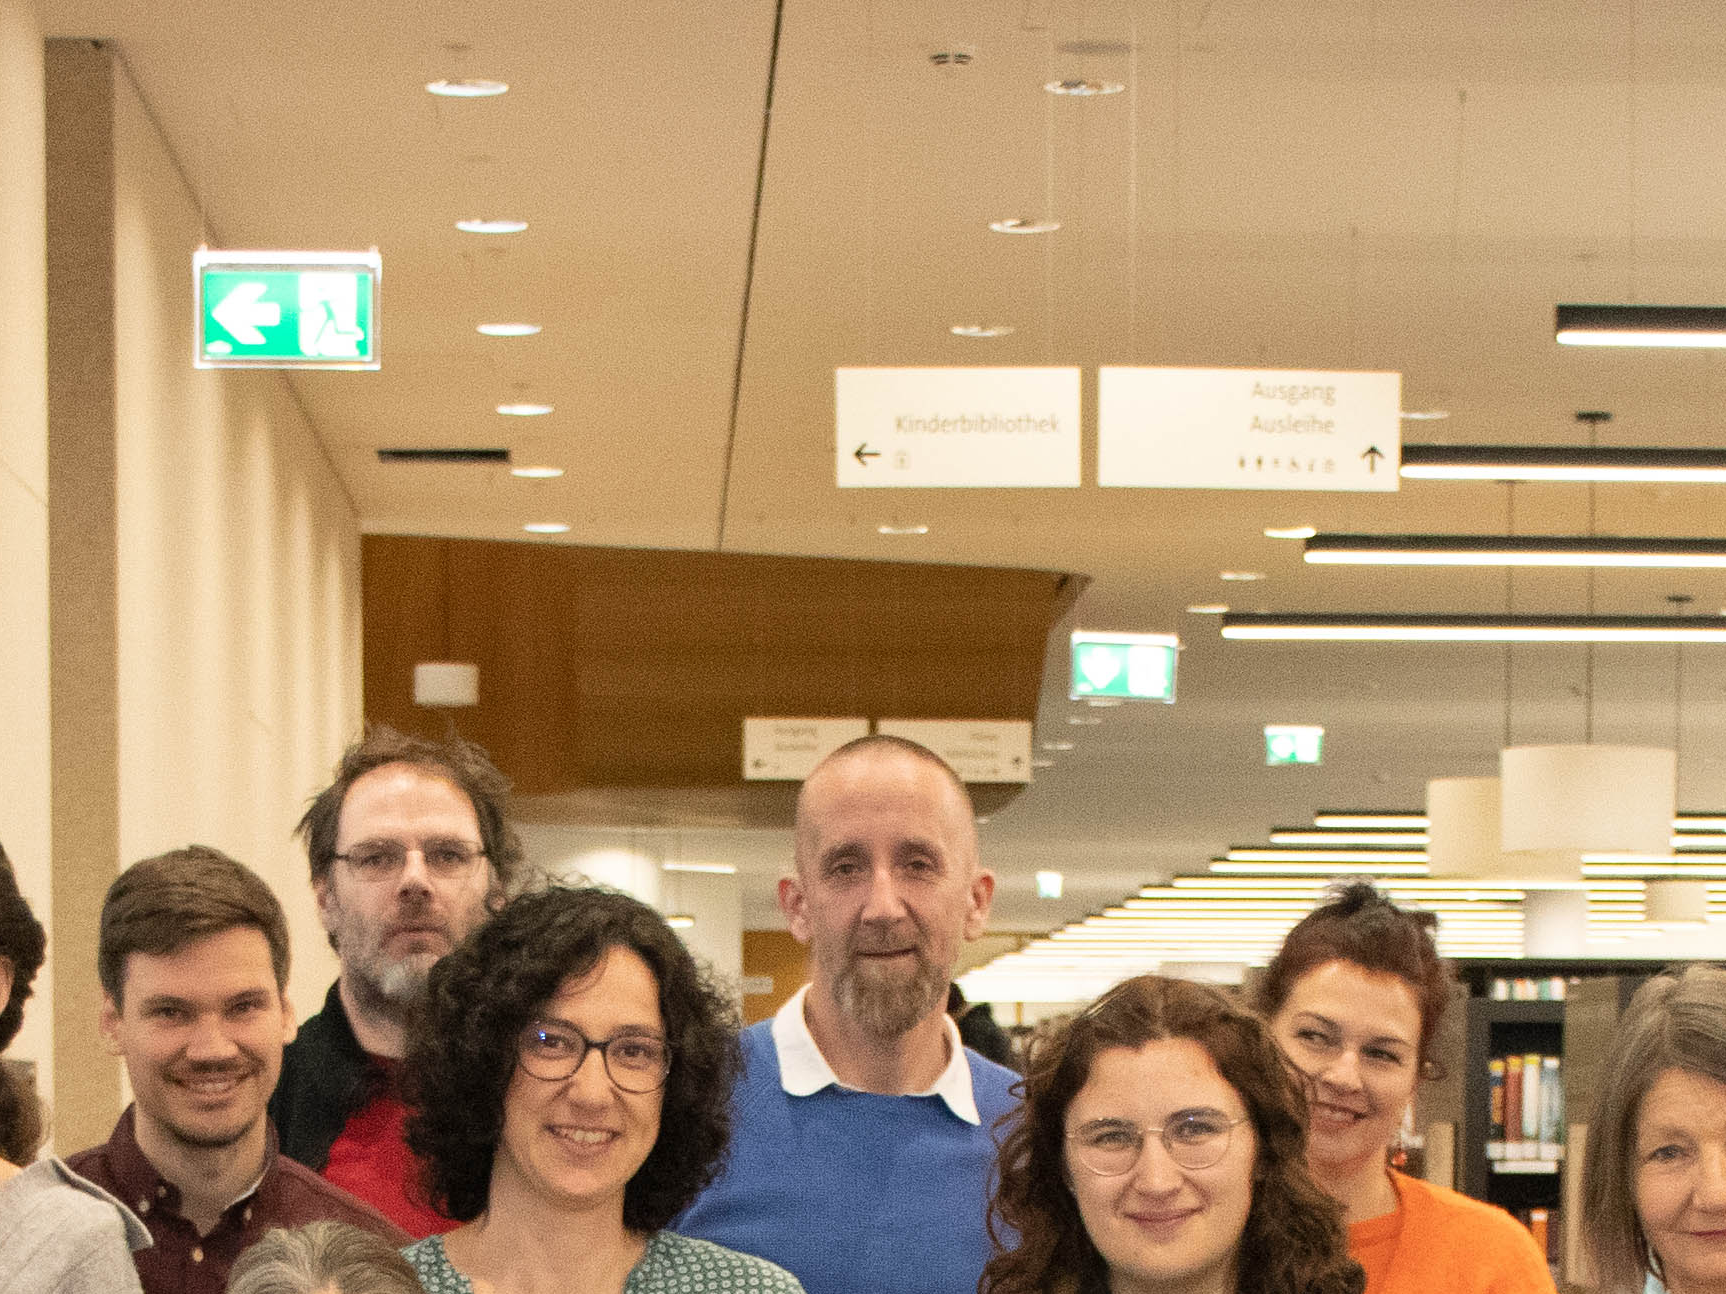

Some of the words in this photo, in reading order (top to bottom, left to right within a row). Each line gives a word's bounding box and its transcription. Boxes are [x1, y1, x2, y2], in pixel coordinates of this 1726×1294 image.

[1252, 381, 1335, 406] Ausgang
[895, 414, 1059, 434] Kinderbibliothek
[1250, 415, 1334, 434] Ausleihe
